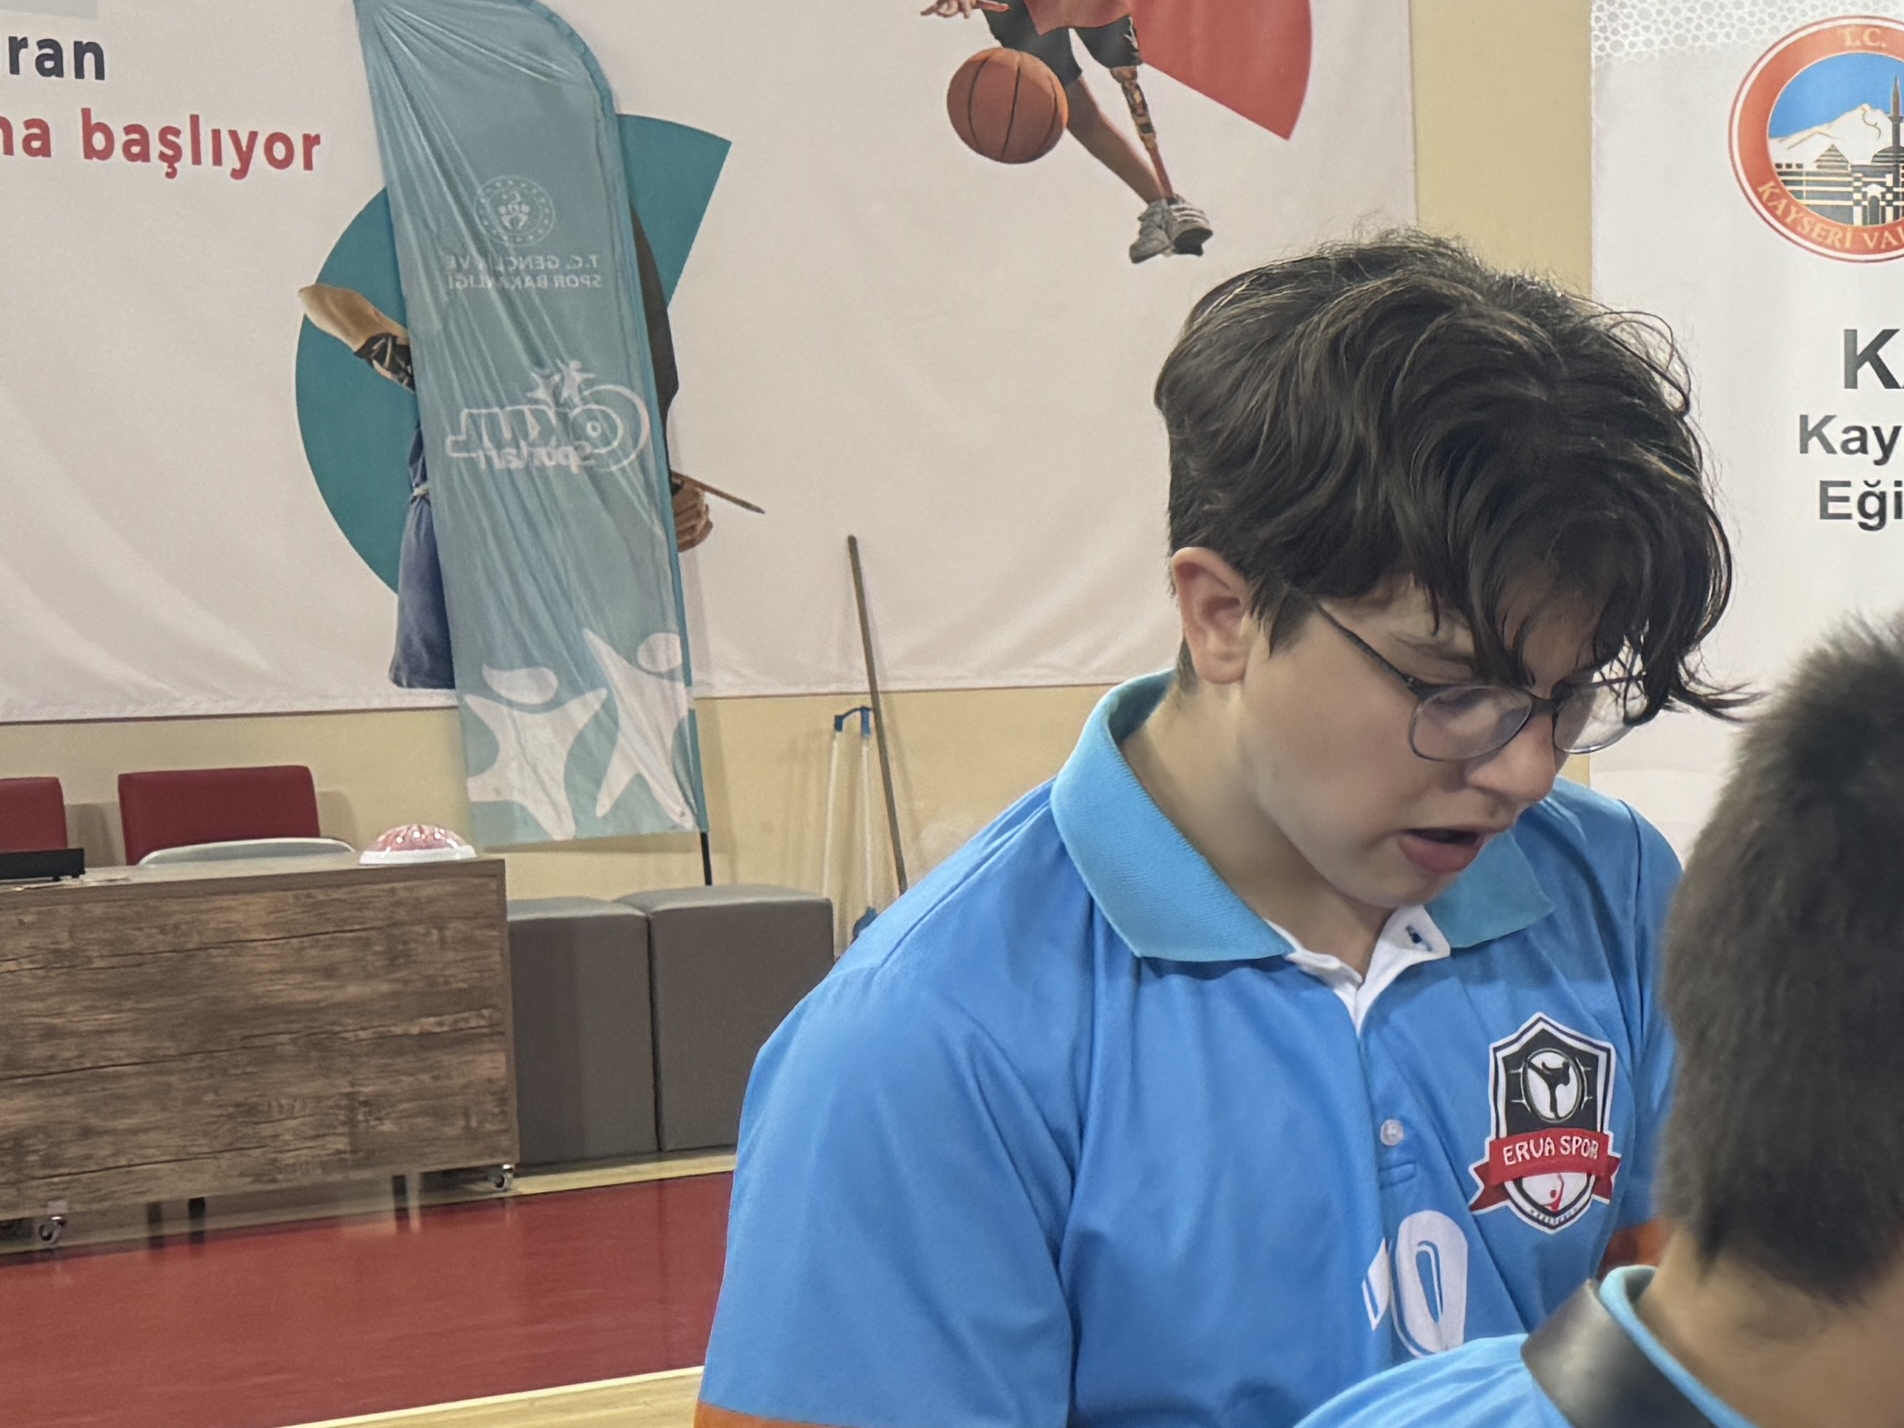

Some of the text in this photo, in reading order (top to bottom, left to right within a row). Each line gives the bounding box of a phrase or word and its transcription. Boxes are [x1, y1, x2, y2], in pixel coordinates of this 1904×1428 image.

[1839, 28, 1887, 48] T.C.
[81, 107, 321, 181] başlıyor
[1757, 180, 1853, 250] KAYSERİ
[1503, 1135, 1599, 1166] ERVA SPOR
